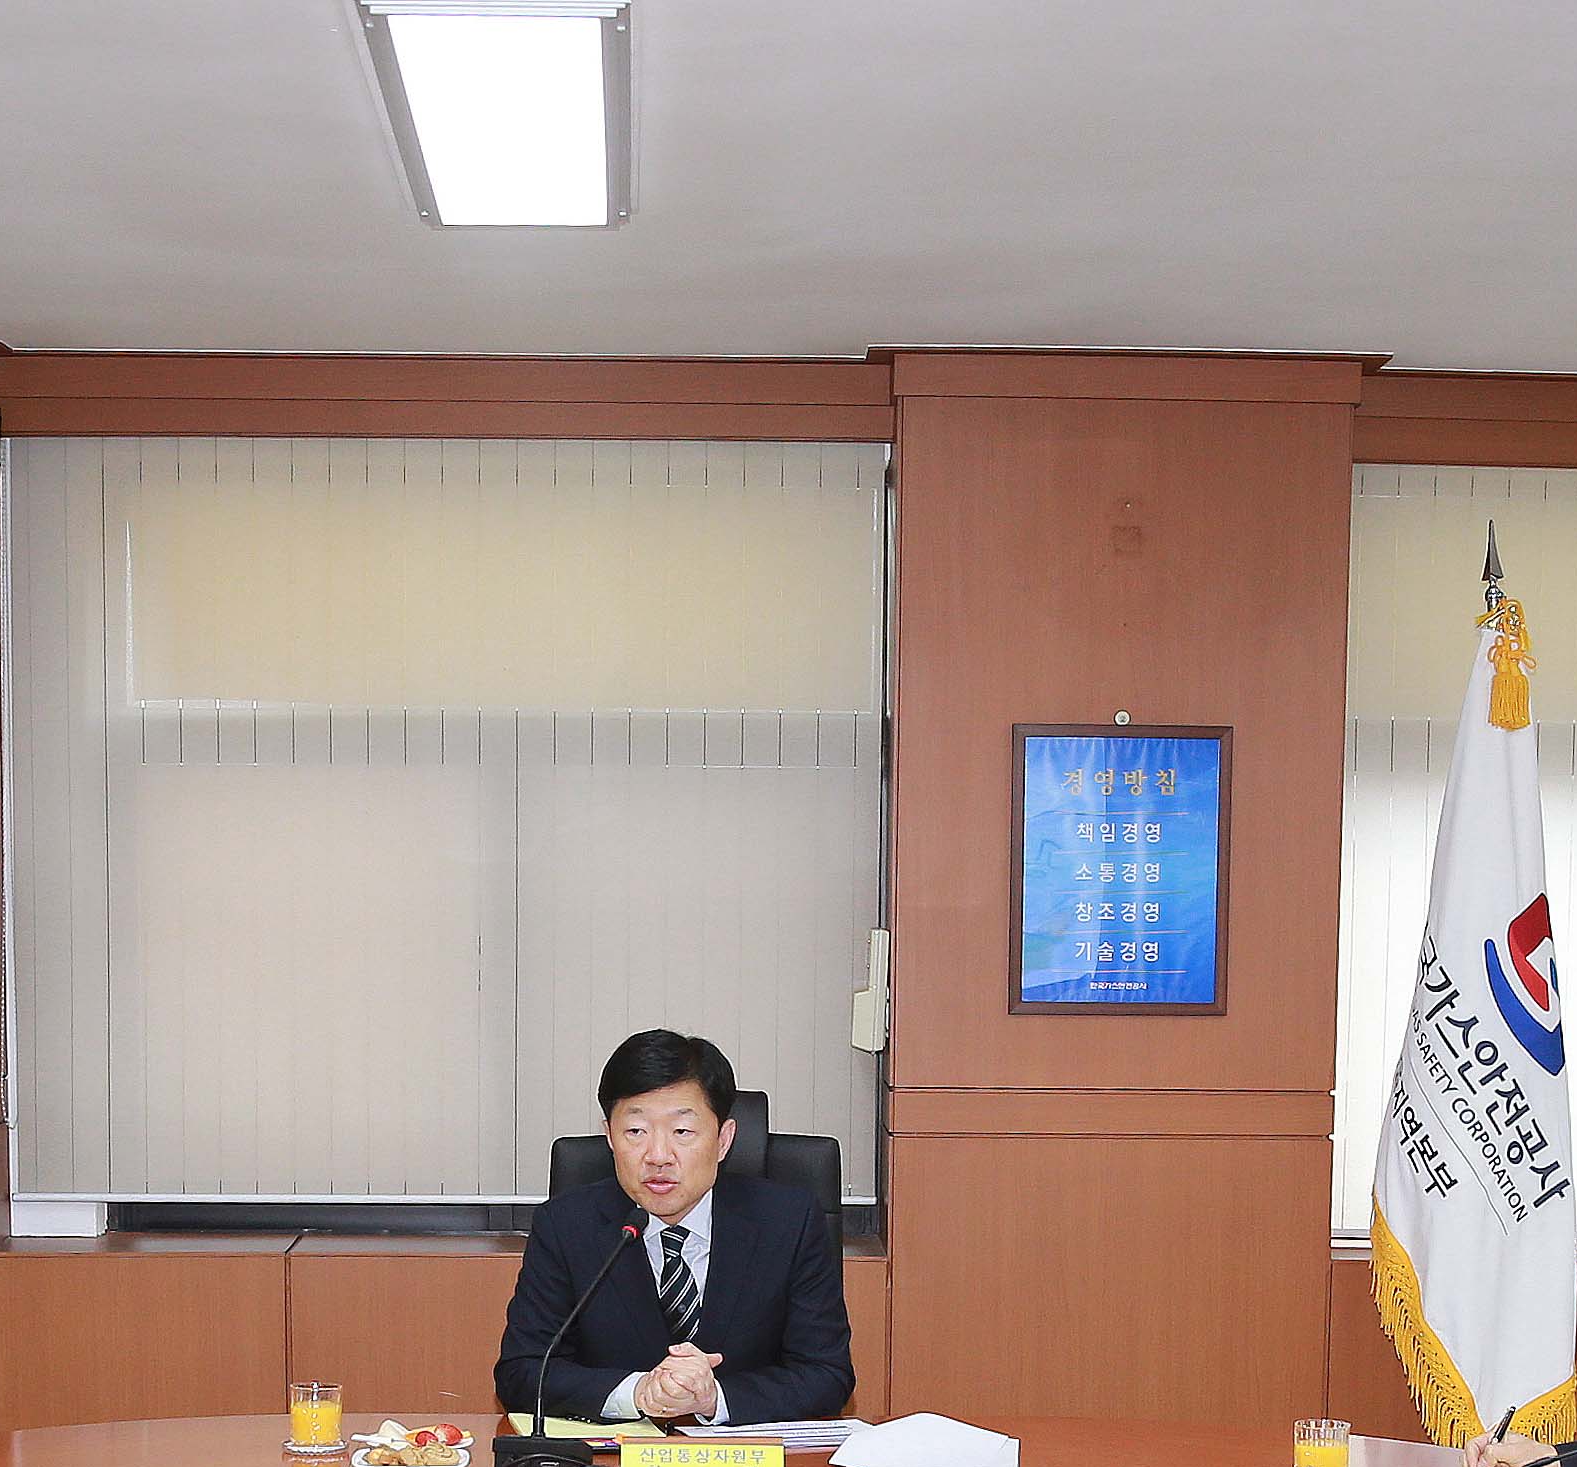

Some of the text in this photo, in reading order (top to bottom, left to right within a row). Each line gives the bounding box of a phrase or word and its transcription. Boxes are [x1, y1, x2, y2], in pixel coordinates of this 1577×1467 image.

[1060, 768, 1177, 797] 경영방침
[1076, 822, 1162, 843] 책임경영
[1075, 863, 1161, 883] 소통경영
[1075, 902, 1161, 923] 창조경영
[1074, 941, 1160, 962] 기술경영
[1419, 924, 1570, 1207] 국가스안전공사
[1416, 1032, 1458, 1094] SAFETY
[1452, 1098, 1529, 1224] CORPORATION
[639, 1449, 766, 1465] 산업통상자원부
